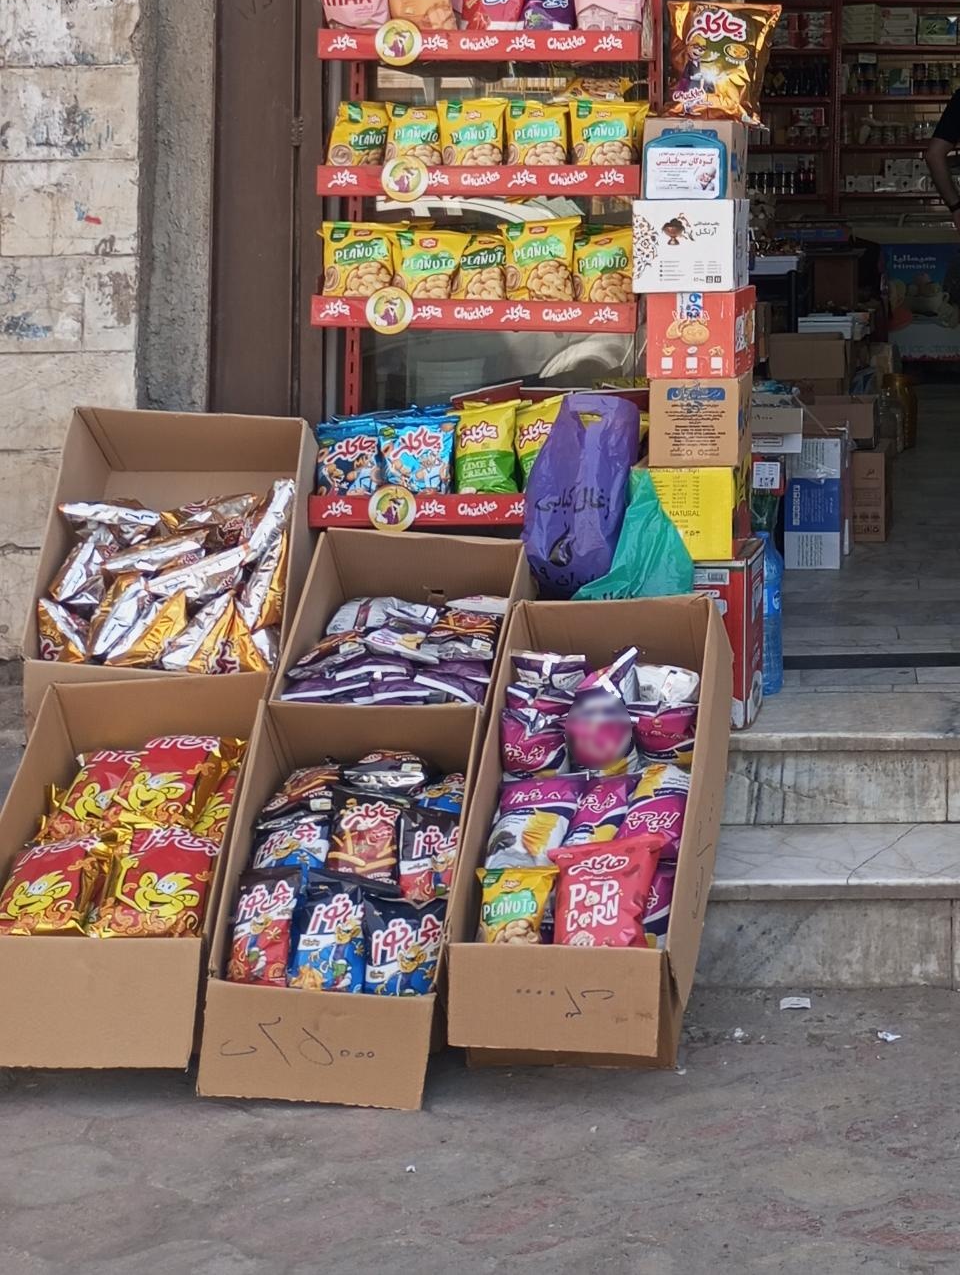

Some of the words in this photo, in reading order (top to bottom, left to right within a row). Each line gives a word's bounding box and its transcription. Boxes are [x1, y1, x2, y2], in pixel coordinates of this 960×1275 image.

[459, 36, 499, 51] Chuckles
[547, 35, 586, 51] Chuckles
[460, 171, 500, 187] Chuckles
[548, 171, 588, 187] Chuckles
[453, 306, 494, 323] Chuckles
[541, 306, 582, 324] Chuckles
[457, 501, 498, 517] Chuckles
[482, 899, 538, 921] PEANUTO
